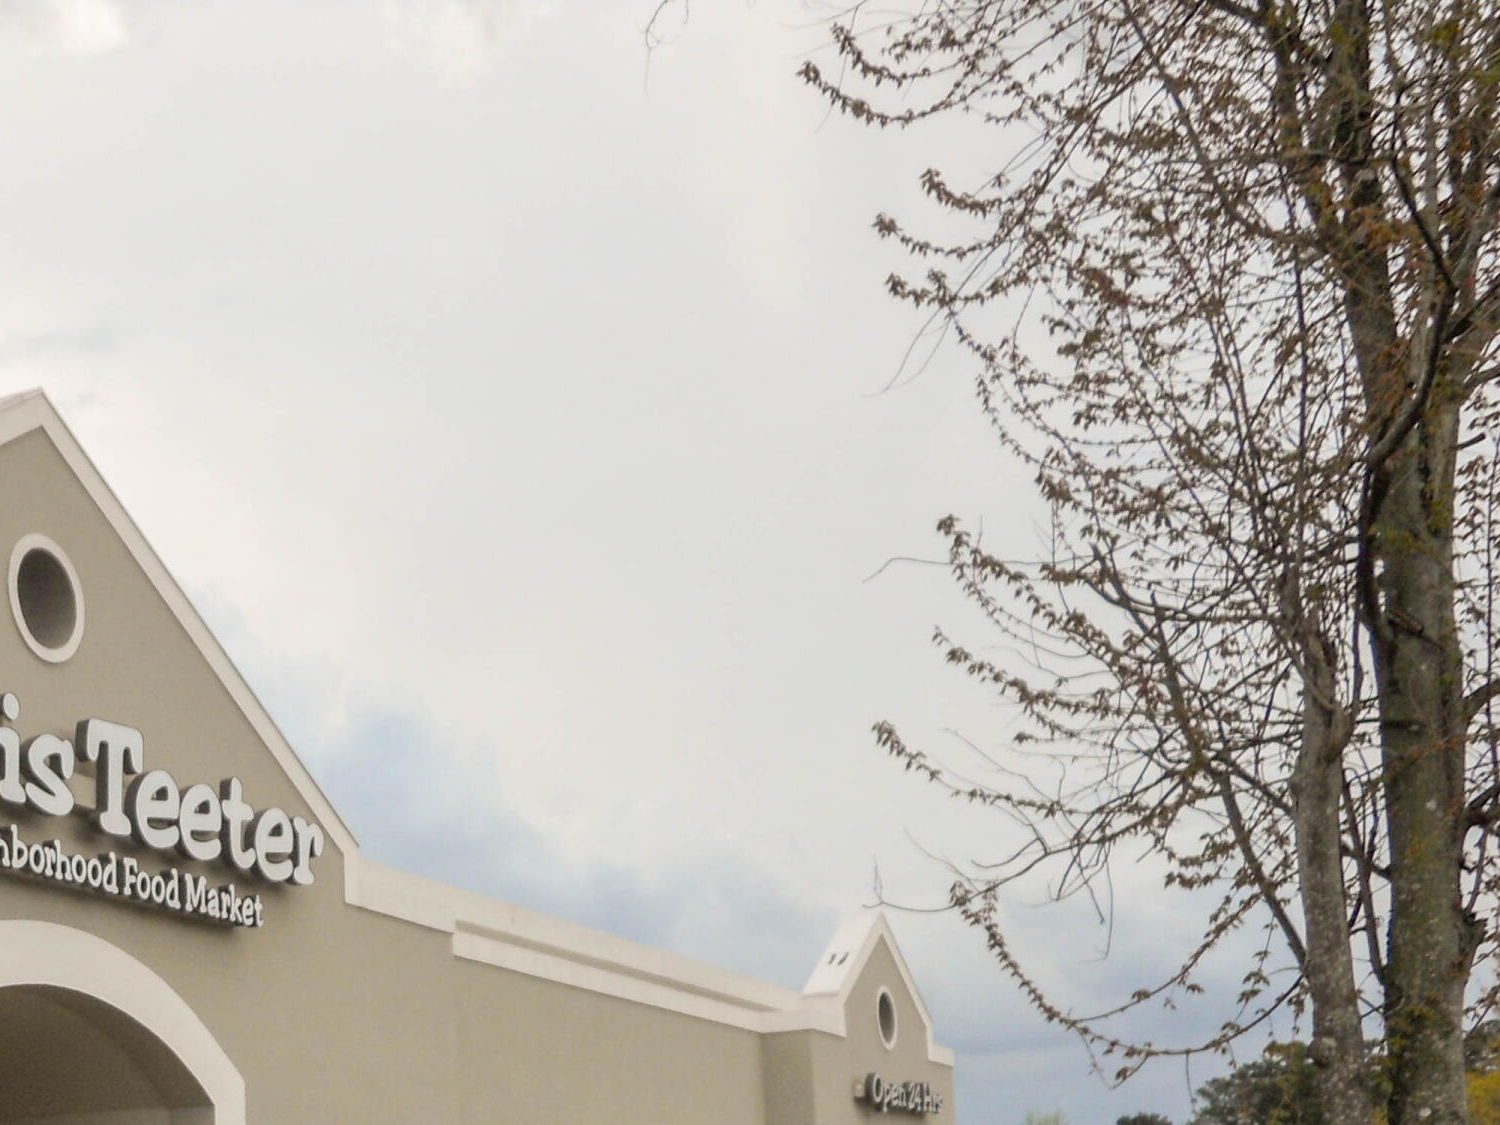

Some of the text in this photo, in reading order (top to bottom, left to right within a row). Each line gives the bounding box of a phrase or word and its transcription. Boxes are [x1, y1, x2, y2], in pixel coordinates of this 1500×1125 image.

[77, 718, 325, 886] Teeter
[122, 855, 182, 912] Food
[184, 872, 265, 929] Market
[869, 1073, 907, 1113] Open
